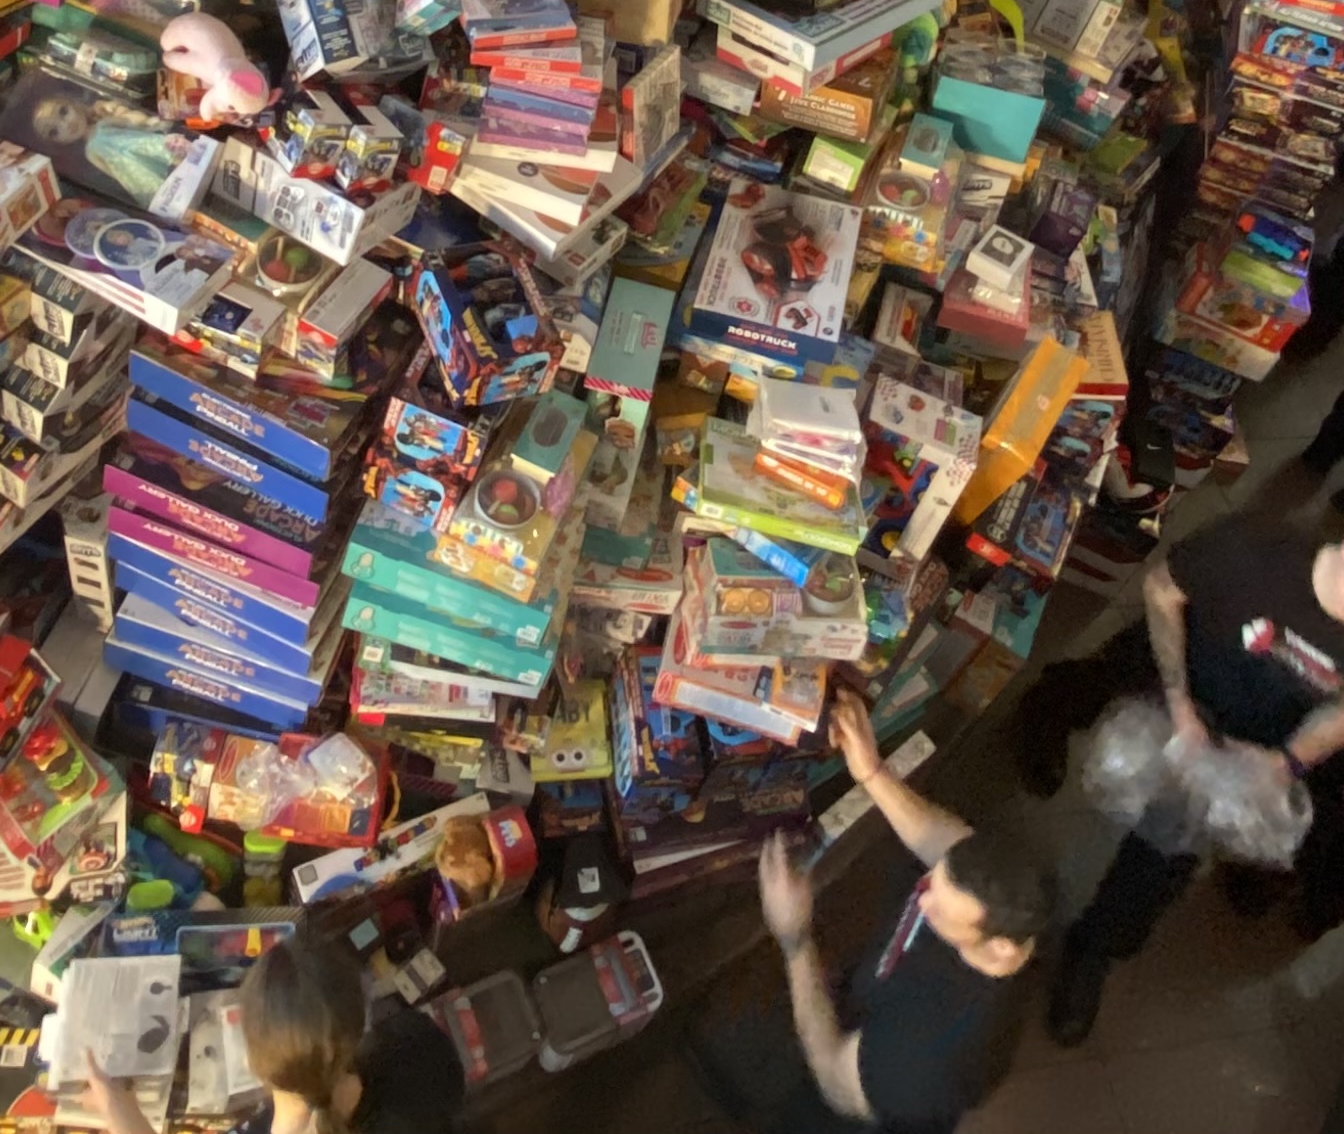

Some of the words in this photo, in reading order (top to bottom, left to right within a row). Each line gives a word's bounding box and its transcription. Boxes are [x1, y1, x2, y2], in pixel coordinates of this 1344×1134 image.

[728, 325, 797, 350] ROBOTRUCK
[196, 405, 249, 436] PINBALL
[138, 484, 201, 514] GALLERY
[223, 480, 283, 510] GALLERY
[202, 508, 239, 532] DUCK
[243, 500, 321, 543] ARCADE
[282, 503, 318, 527] DUCK
[143, 522, 207, 551] GALLERY
[209, 546, 246, 567] DUCK
